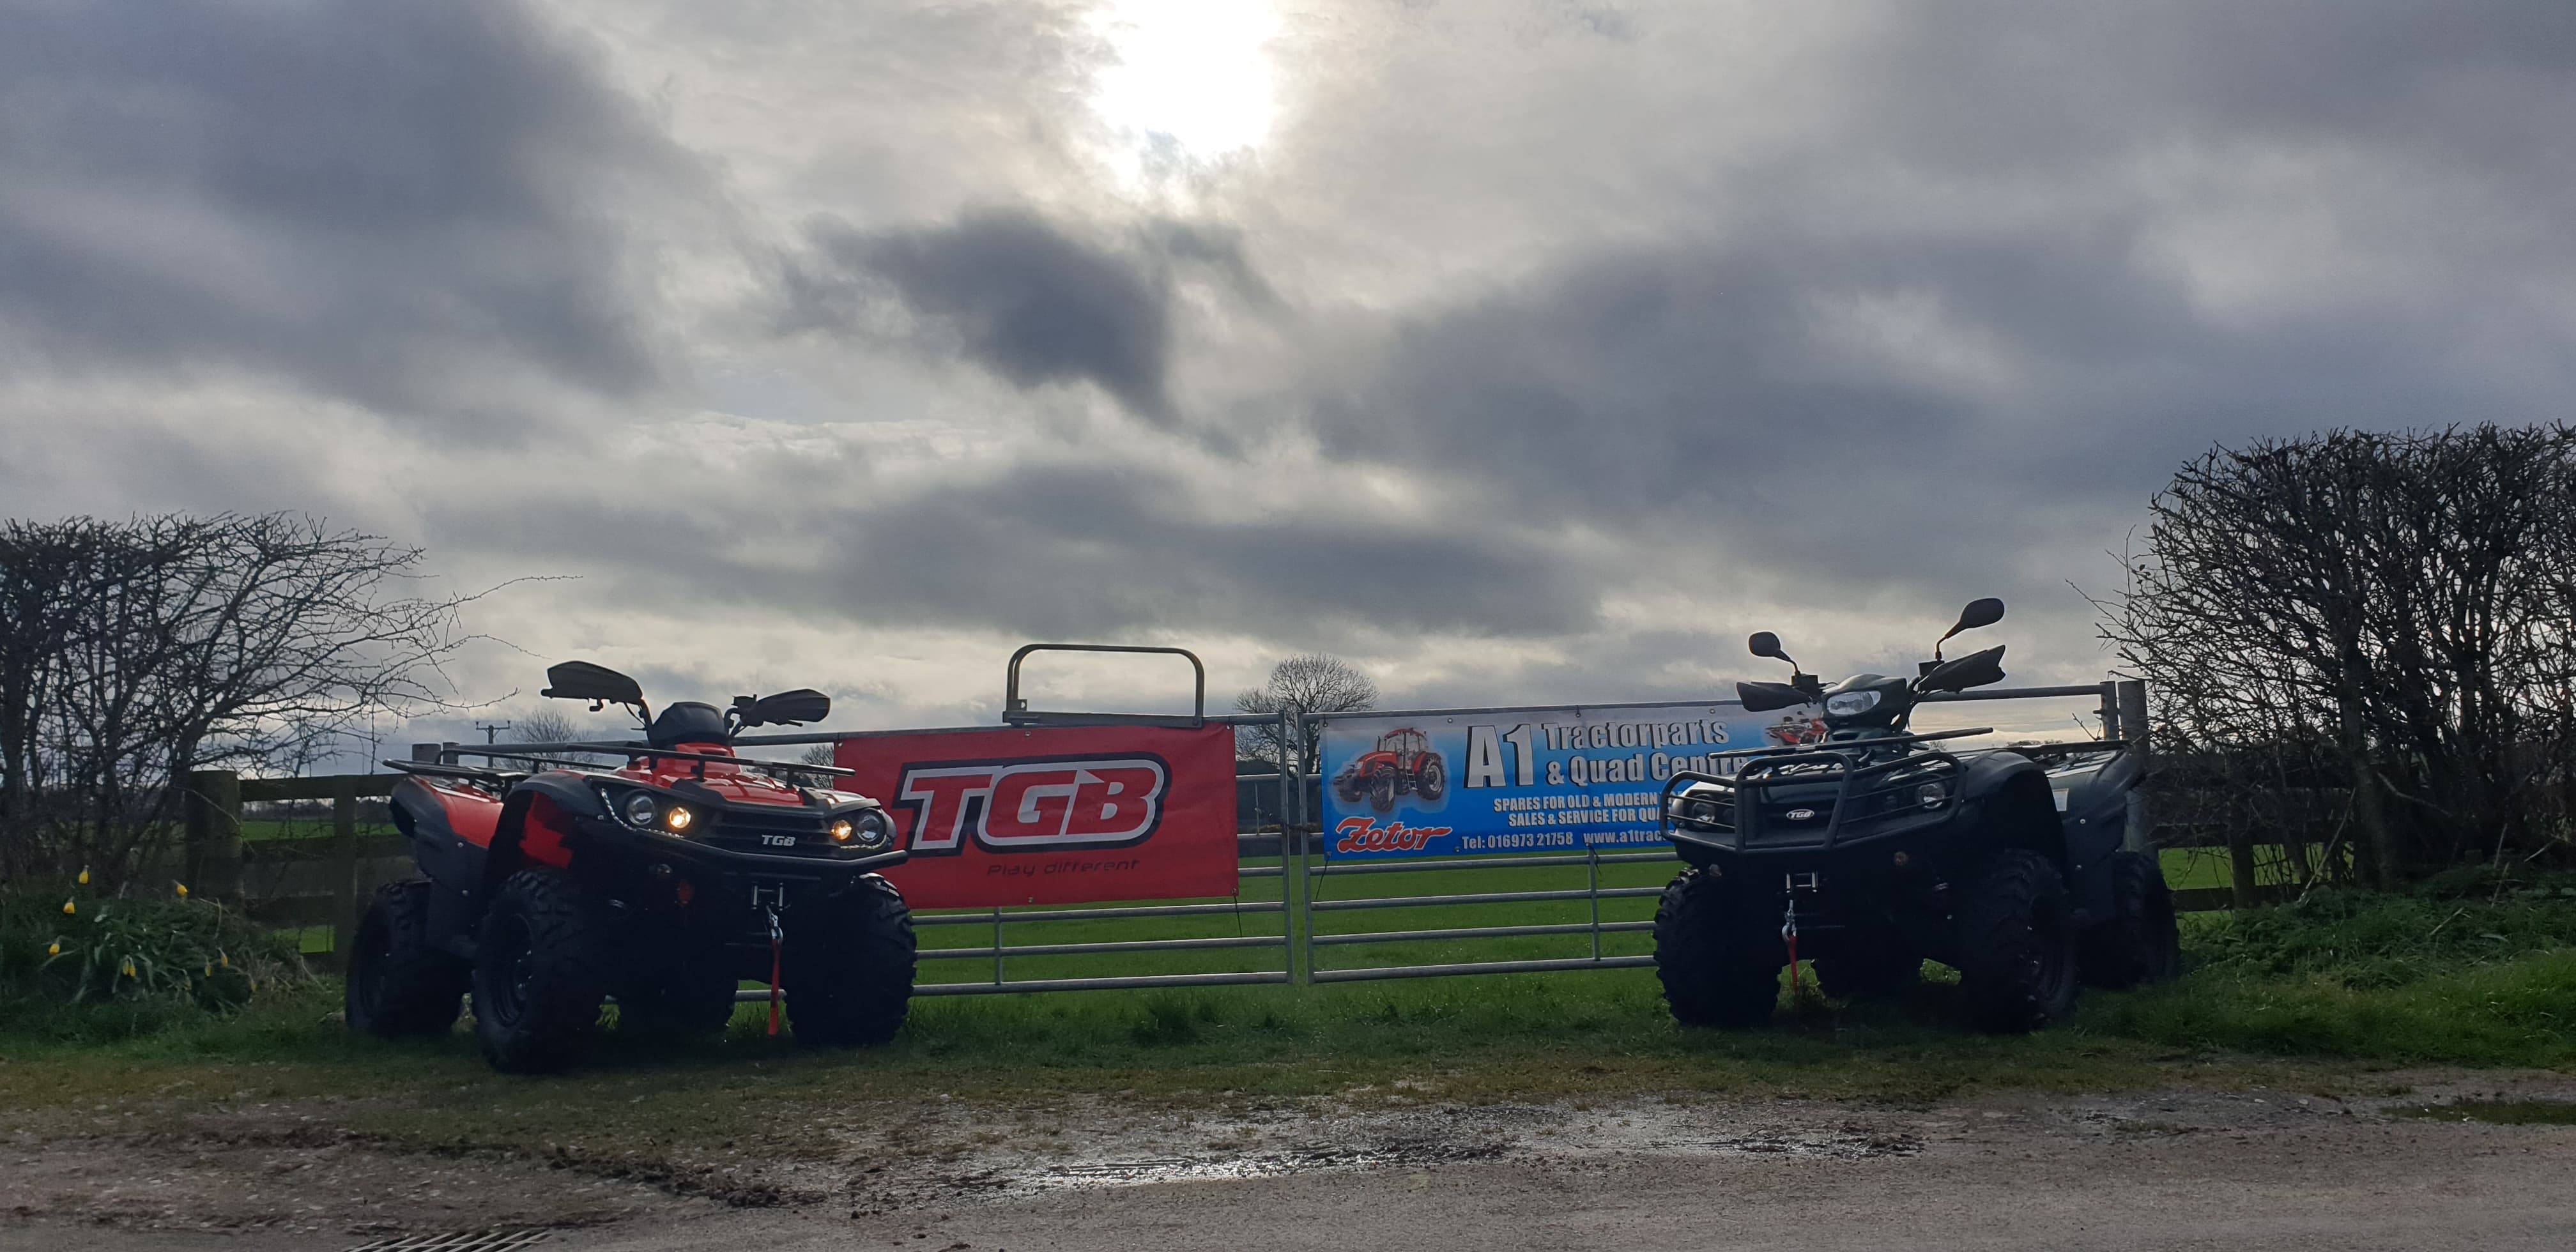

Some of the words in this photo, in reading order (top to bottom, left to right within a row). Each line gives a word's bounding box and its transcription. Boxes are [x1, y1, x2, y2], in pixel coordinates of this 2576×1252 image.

[1542, 720, 1729, 751] Tractorparts
[1466, 724, 1533, 788] A1
[1547, 760, 1564, 784] &
[1570, 754, 1644, 786] Quad
[900, 759, 1165, 850] TGB
[1494, 797, 1540, 812] SPARES
[1543, 795, 1565, 809] FOR
[1567, 795, 1590, 808] OLD
[1593, 796, 1601, 807] &
[1604, 792, 1658, 807] MODERN
[1508, 812, 1545, 827] SALES
[1547, 813, 1556, 825] &
[1558, 809, 1609, 825] SERVICE
[1612, 808, 1636, 822] FOR
[762, 834, 795, 846] TGB
[1335, 816, 1452, 853] Zetor
[1462, 836, 1485, 850] Tel:
[1487, 834, 1533, 848] 016973
[1537, 832, 1573, 846] 21758
[987, 864, 1036, 877] Play
[1044, 859, 1140, 874] different
